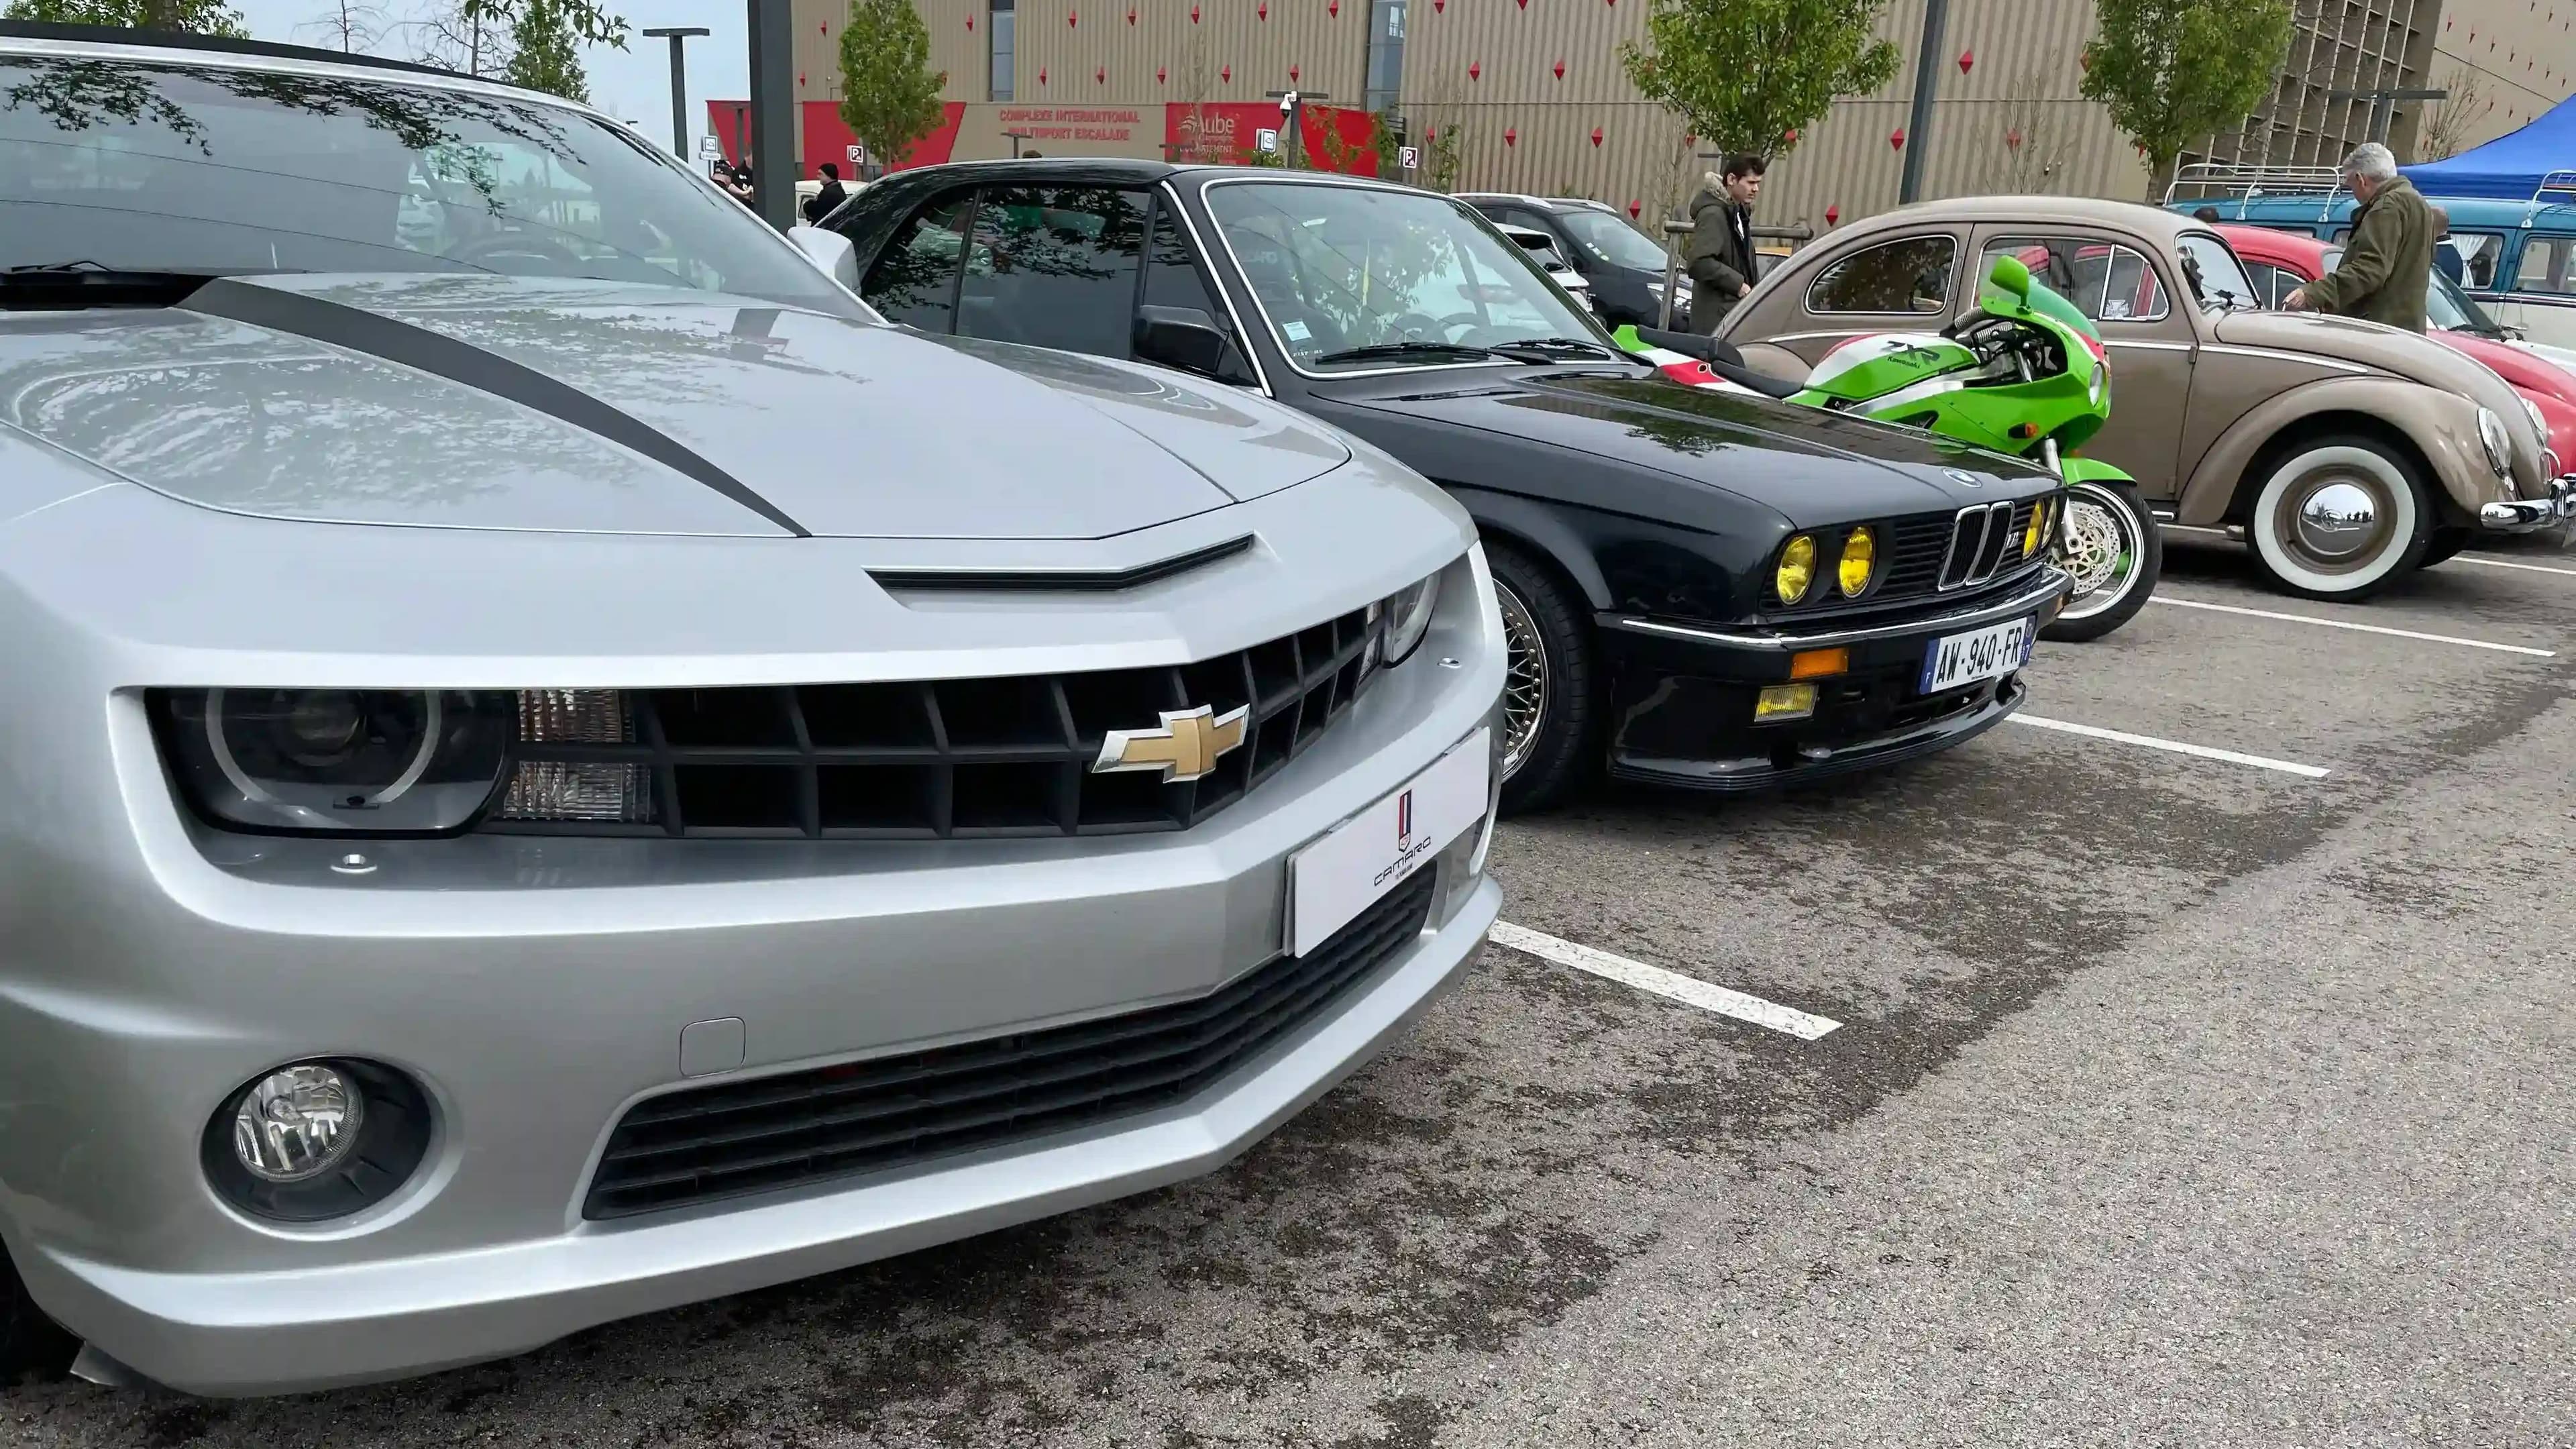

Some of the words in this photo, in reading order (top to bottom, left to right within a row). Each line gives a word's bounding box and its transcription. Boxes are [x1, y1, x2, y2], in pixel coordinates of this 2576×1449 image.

[1056, 110, 1140, 123] INTERNATIONAL
[1075, 128, 1130, 140] ESCALADE
[852, 148, 859, 158] P
[1405, 150, 1413, 163] P
[1887, 356, 1921, 369] Kawasaki
[1373, 835, 1432, 887] CAMARO
